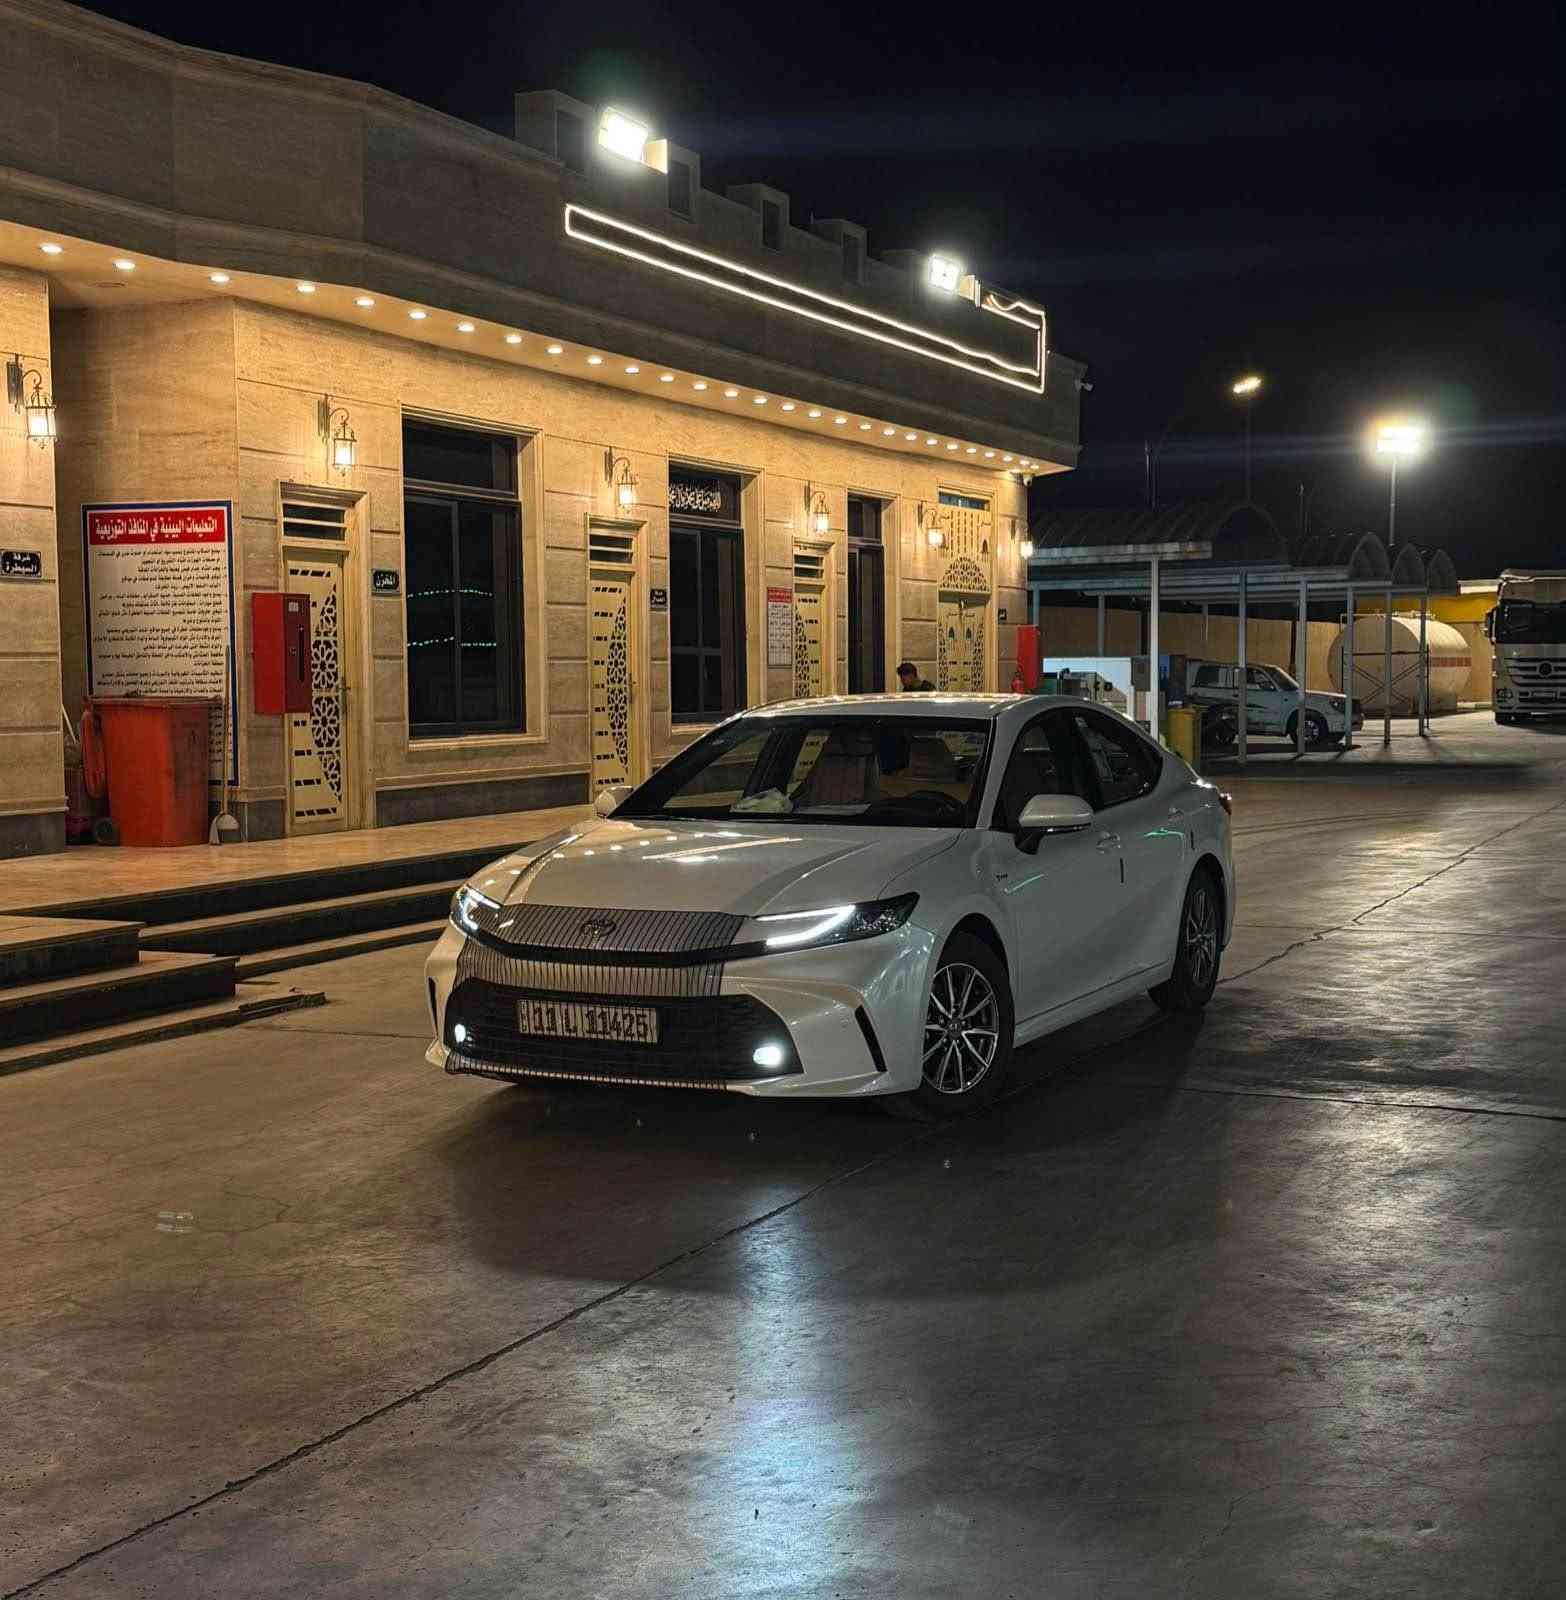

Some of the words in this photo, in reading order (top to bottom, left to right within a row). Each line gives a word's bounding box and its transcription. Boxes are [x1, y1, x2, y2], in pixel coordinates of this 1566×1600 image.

[150, 518, 159, 541] في
[186, 516, 217, 538] التعليمات
[532, 1006, 558, 1032] 11
[585, 1009, 649, 1038] 11425
